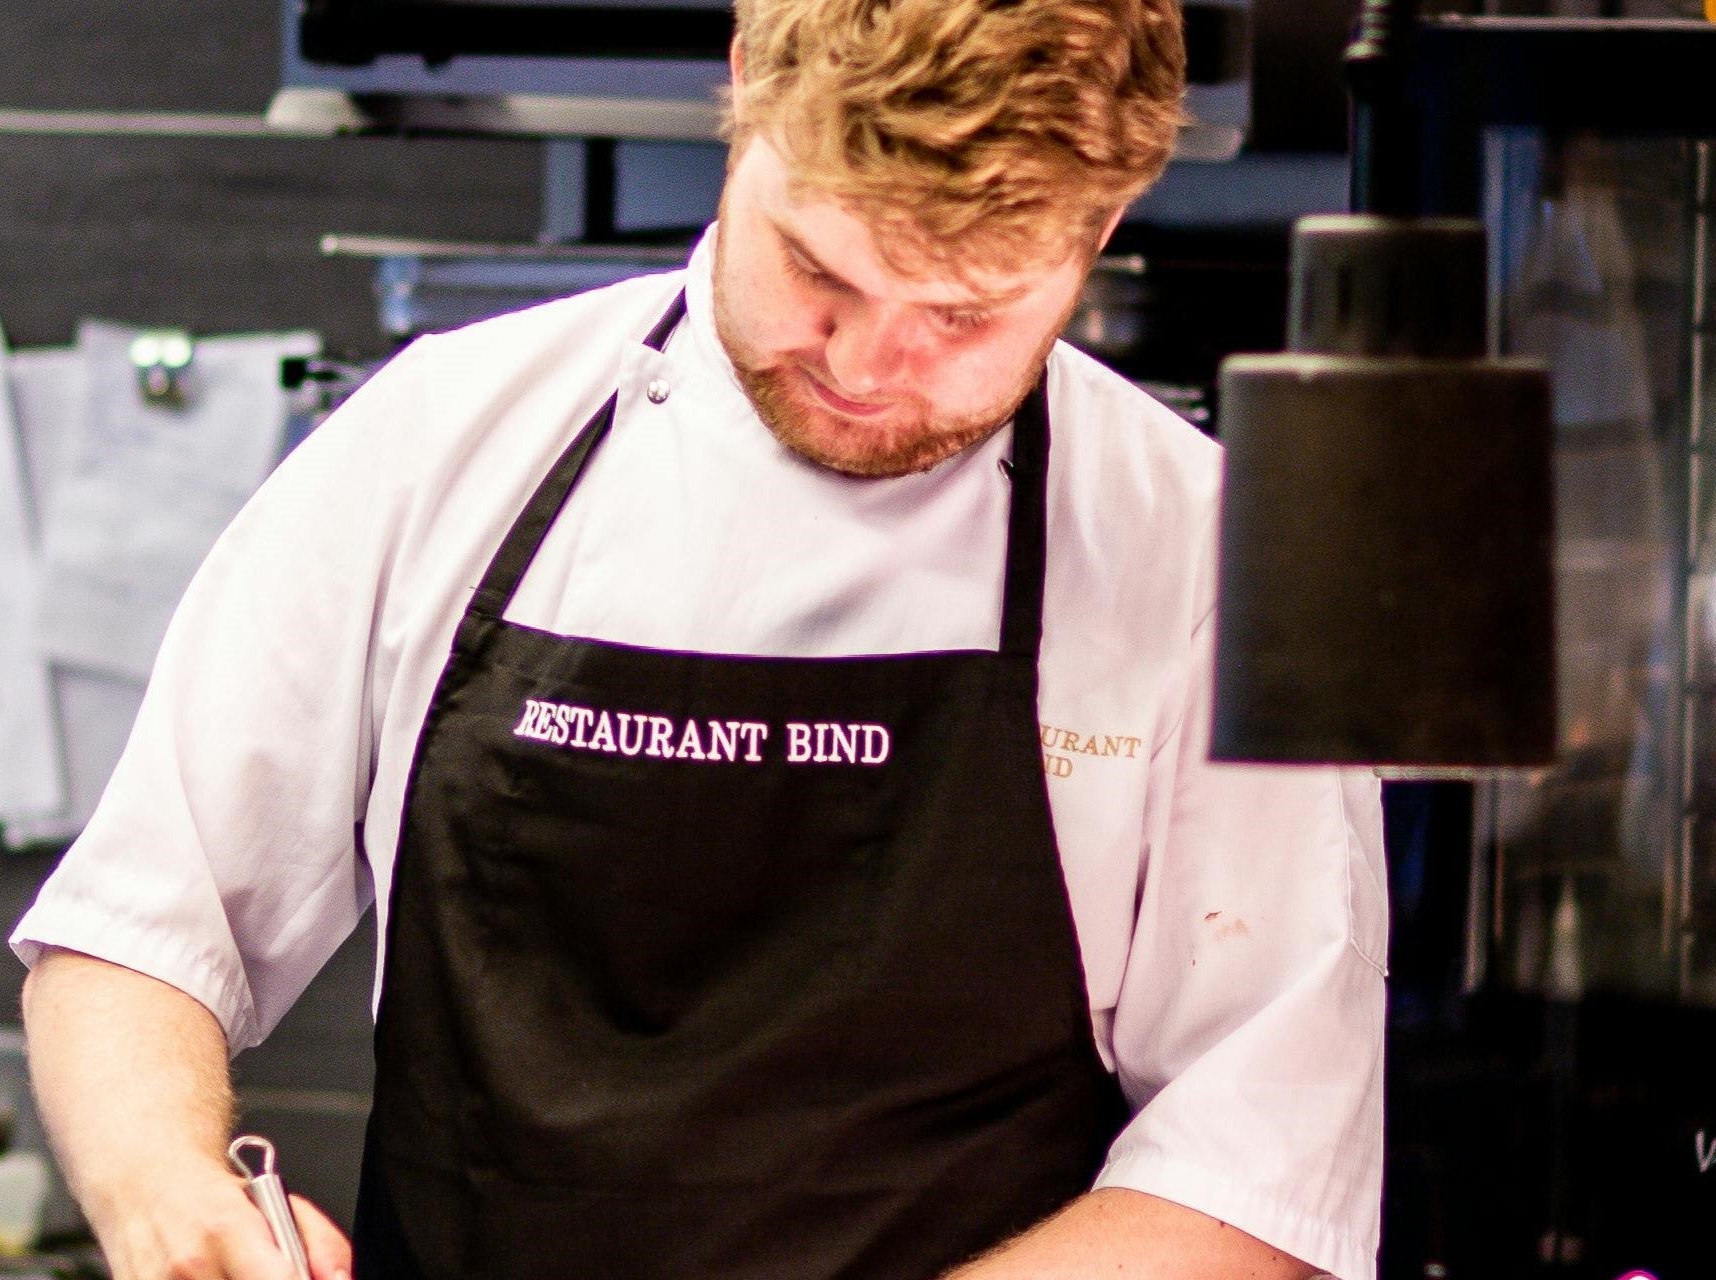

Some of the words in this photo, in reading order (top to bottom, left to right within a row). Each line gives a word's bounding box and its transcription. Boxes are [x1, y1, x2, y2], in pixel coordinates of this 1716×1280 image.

[513, 699, 768, 762] RESTAURANT
[786, 723, 889, 764] BIND
[1040, 724, 1142, 759] URANT
